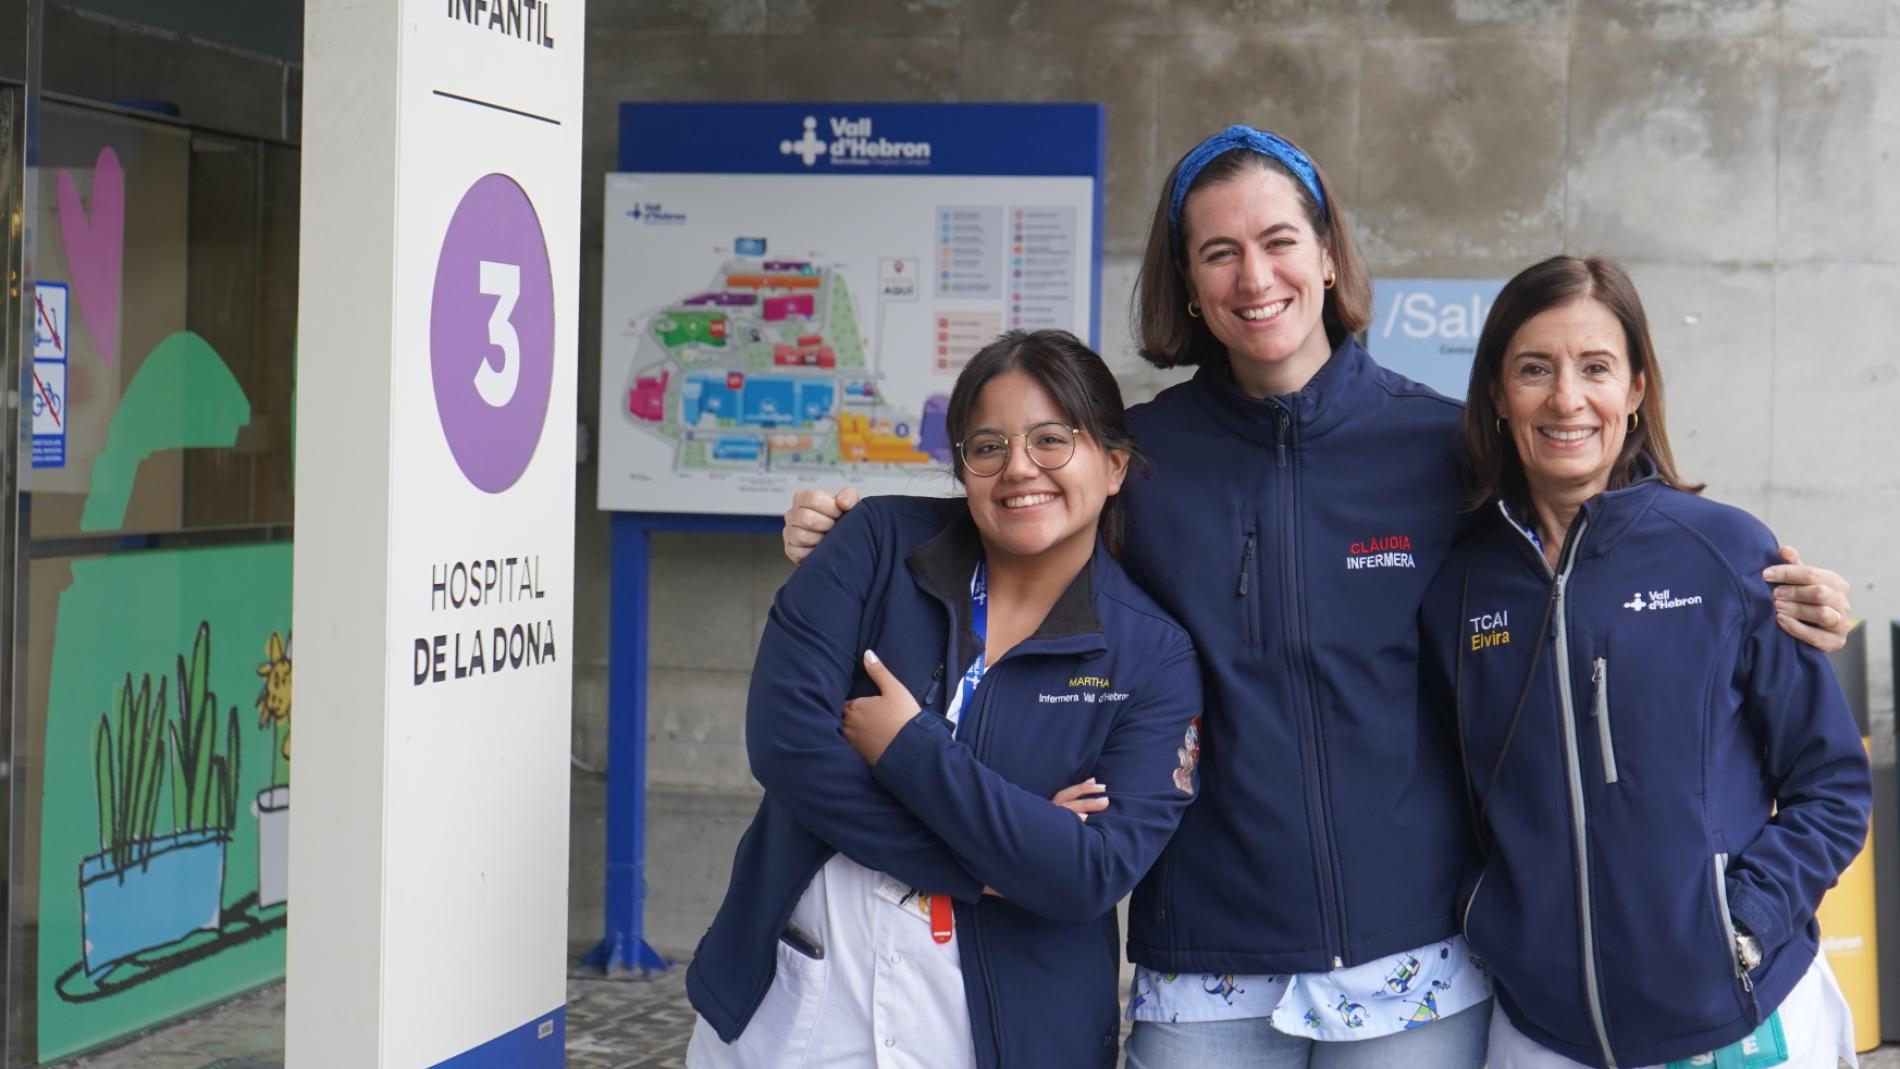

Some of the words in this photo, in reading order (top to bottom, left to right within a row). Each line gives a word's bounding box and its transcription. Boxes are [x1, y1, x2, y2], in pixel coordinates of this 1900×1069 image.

[829, 117, 872, 137] Vall
[829, 137, 932, 158] d'Hebron
[1383, 291, 1489, 339] /Sal
[472, 259, 522, 408] 3
[1346, 552, 1416, 570] INFERMERA
[431, 554, 545, 611] HOSPITAL
[1648, 589, 1670, 600] Vall
[1648, 595, 1703, 610] d'Hebron
[1469, 609, 1508, 633] TCAI
[1471, 629, 1511, 652] Elvira
[413, 634, 447, 686] DE
[455, 629, 486, 680] LA
[492, 619, 556, 673] DONA
[1068, 676, 1110, 688] MARTHA
[1038, 693, 1080, 703] Infermera
